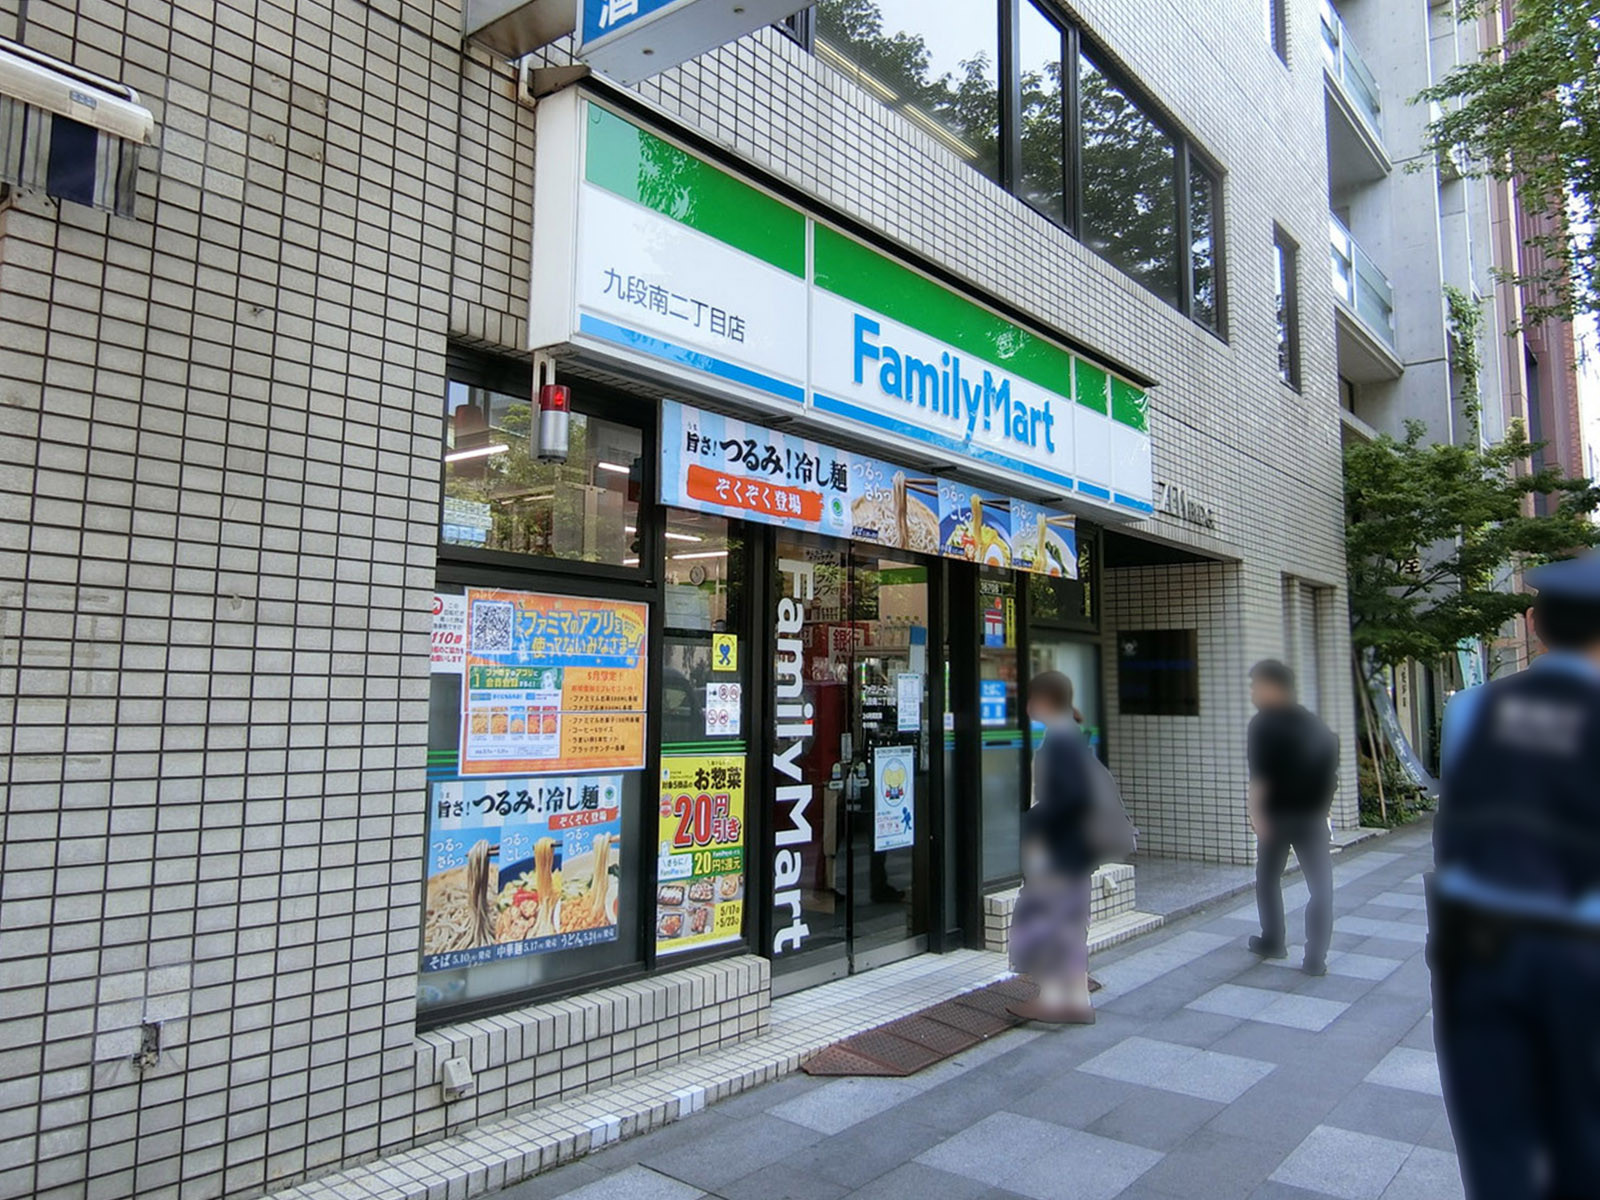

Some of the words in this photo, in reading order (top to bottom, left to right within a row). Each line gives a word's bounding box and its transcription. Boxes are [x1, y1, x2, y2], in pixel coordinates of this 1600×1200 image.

[602, 266, 746, 343] 九段南二丁目店
[853, 312, 1055, 454] FamilyMart
[715, 478, 802, 514] ぞくぞく登場
[694, 767, 742, 790] お惣菜
[773, 558, 814, 954] FamilyMart
[559, 810, 608, 827] ぞくぞく登場
[674, 793, 712, 848] 20
